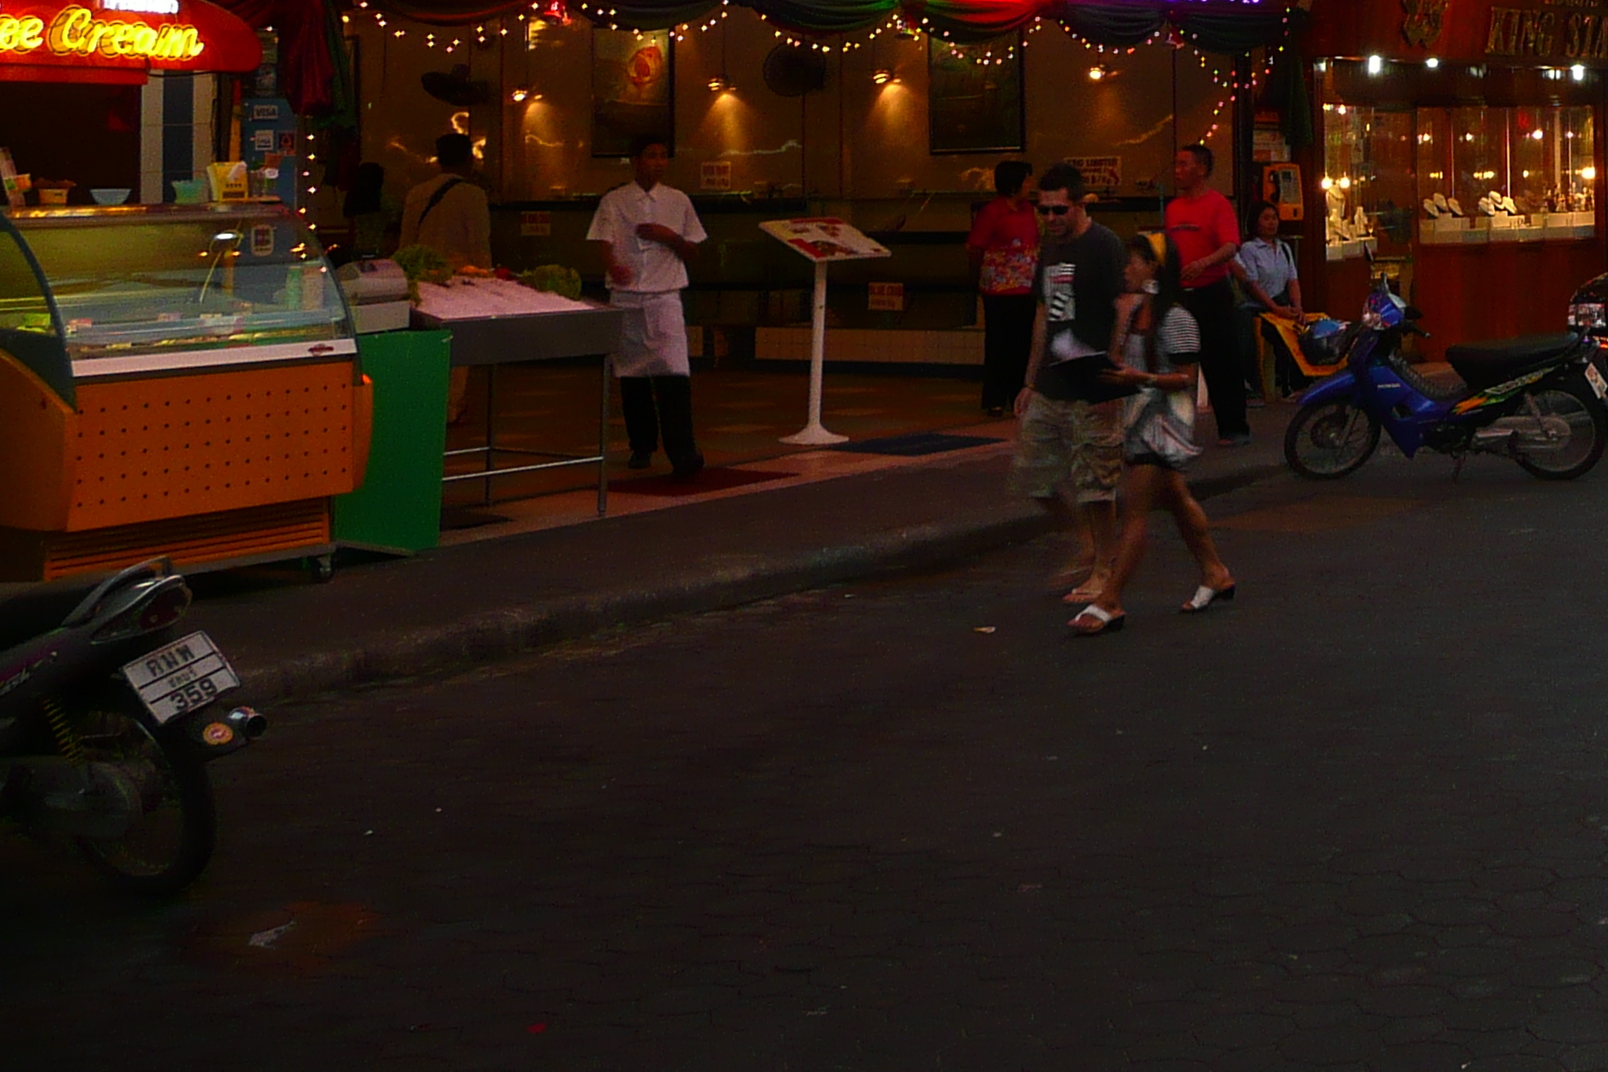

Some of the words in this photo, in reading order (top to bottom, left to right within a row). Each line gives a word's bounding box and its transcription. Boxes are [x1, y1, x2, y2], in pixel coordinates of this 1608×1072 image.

[50, 6, 205, 60] Cream
[1484, 5, 1557, 58] KING
[170, 678, 219, 711] 359
